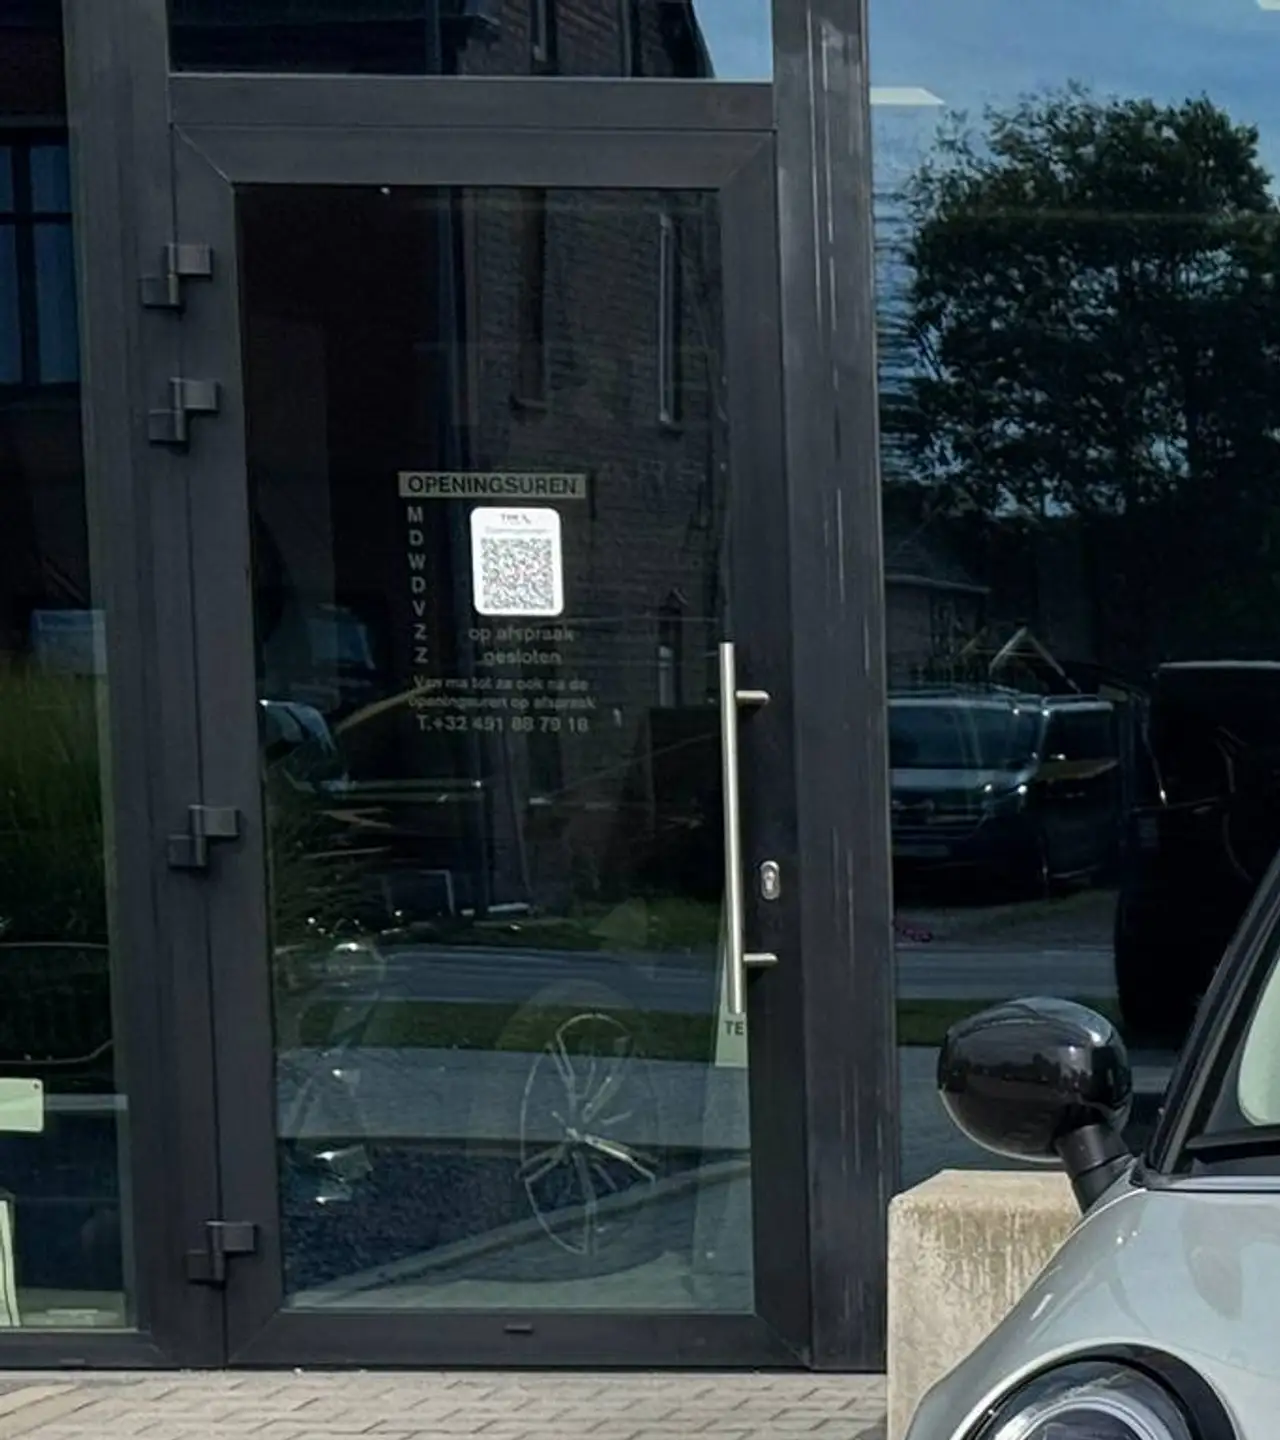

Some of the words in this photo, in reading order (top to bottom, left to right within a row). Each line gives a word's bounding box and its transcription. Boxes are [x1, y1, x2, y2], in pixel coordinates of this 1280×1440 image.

[407, 475, 577, 496] OPENINGSUREN
[407, 506, 424, 523] M
[409, 530, 424, 546] D
[407, 553, 426, 571] W
[410, 577, 426, 593] D
[412, 600, 426, 617] V
[413, 624, 428, 640] Z
[468, 628, 490, 644] op
[496, 625, 575, 643] afspraak
[414, 647, 429, 663] Z
[483, 650, 562, 667] gesloten
